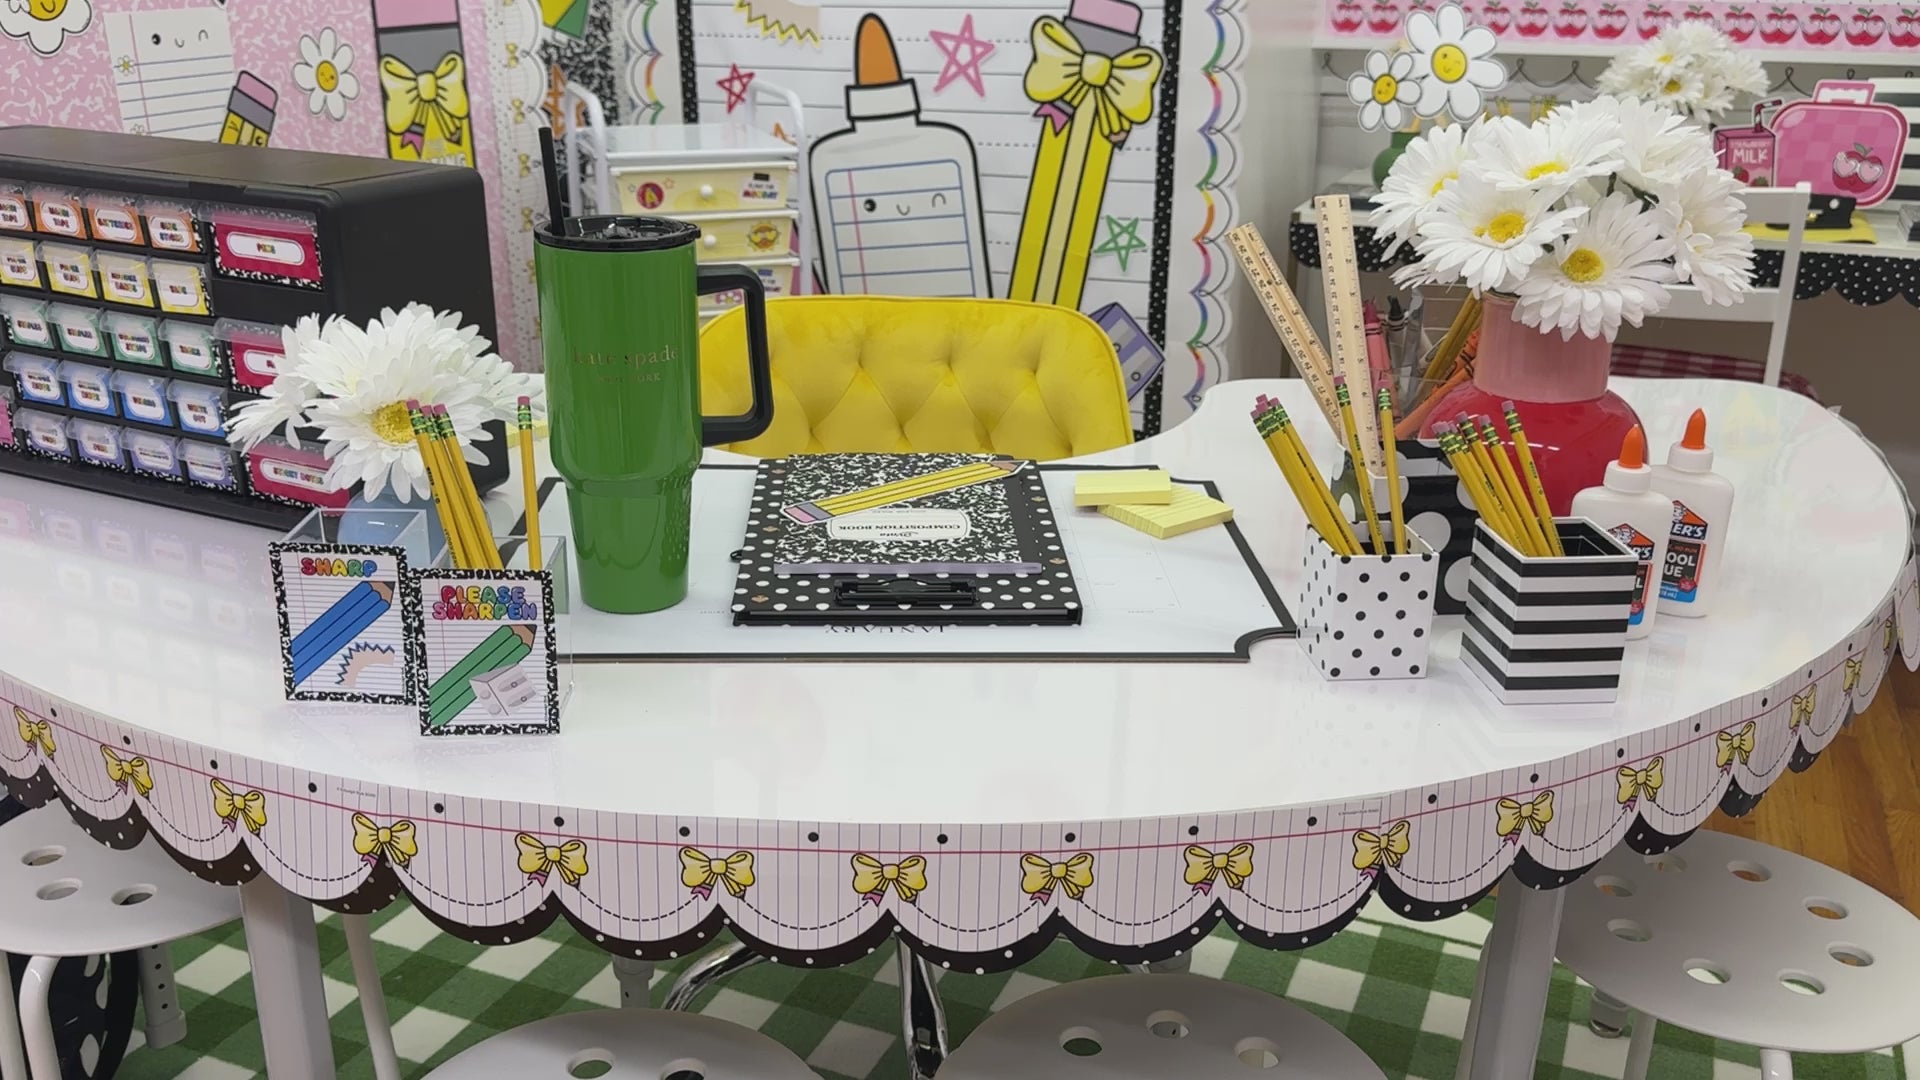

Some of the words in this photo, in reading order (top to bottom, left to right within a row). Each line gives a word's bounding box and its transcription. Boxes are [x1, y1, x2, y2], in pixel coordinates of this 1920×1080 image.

[1732, 148, 1768, 164] MILK
[573, 346, 616, 366] kate
[624, 344, 679, 369] spade
[300, 557, 378, 578] SHARP
[440, 585, 526, 603] PLEASE
[432, 602, 538, 621] SHARPEN
